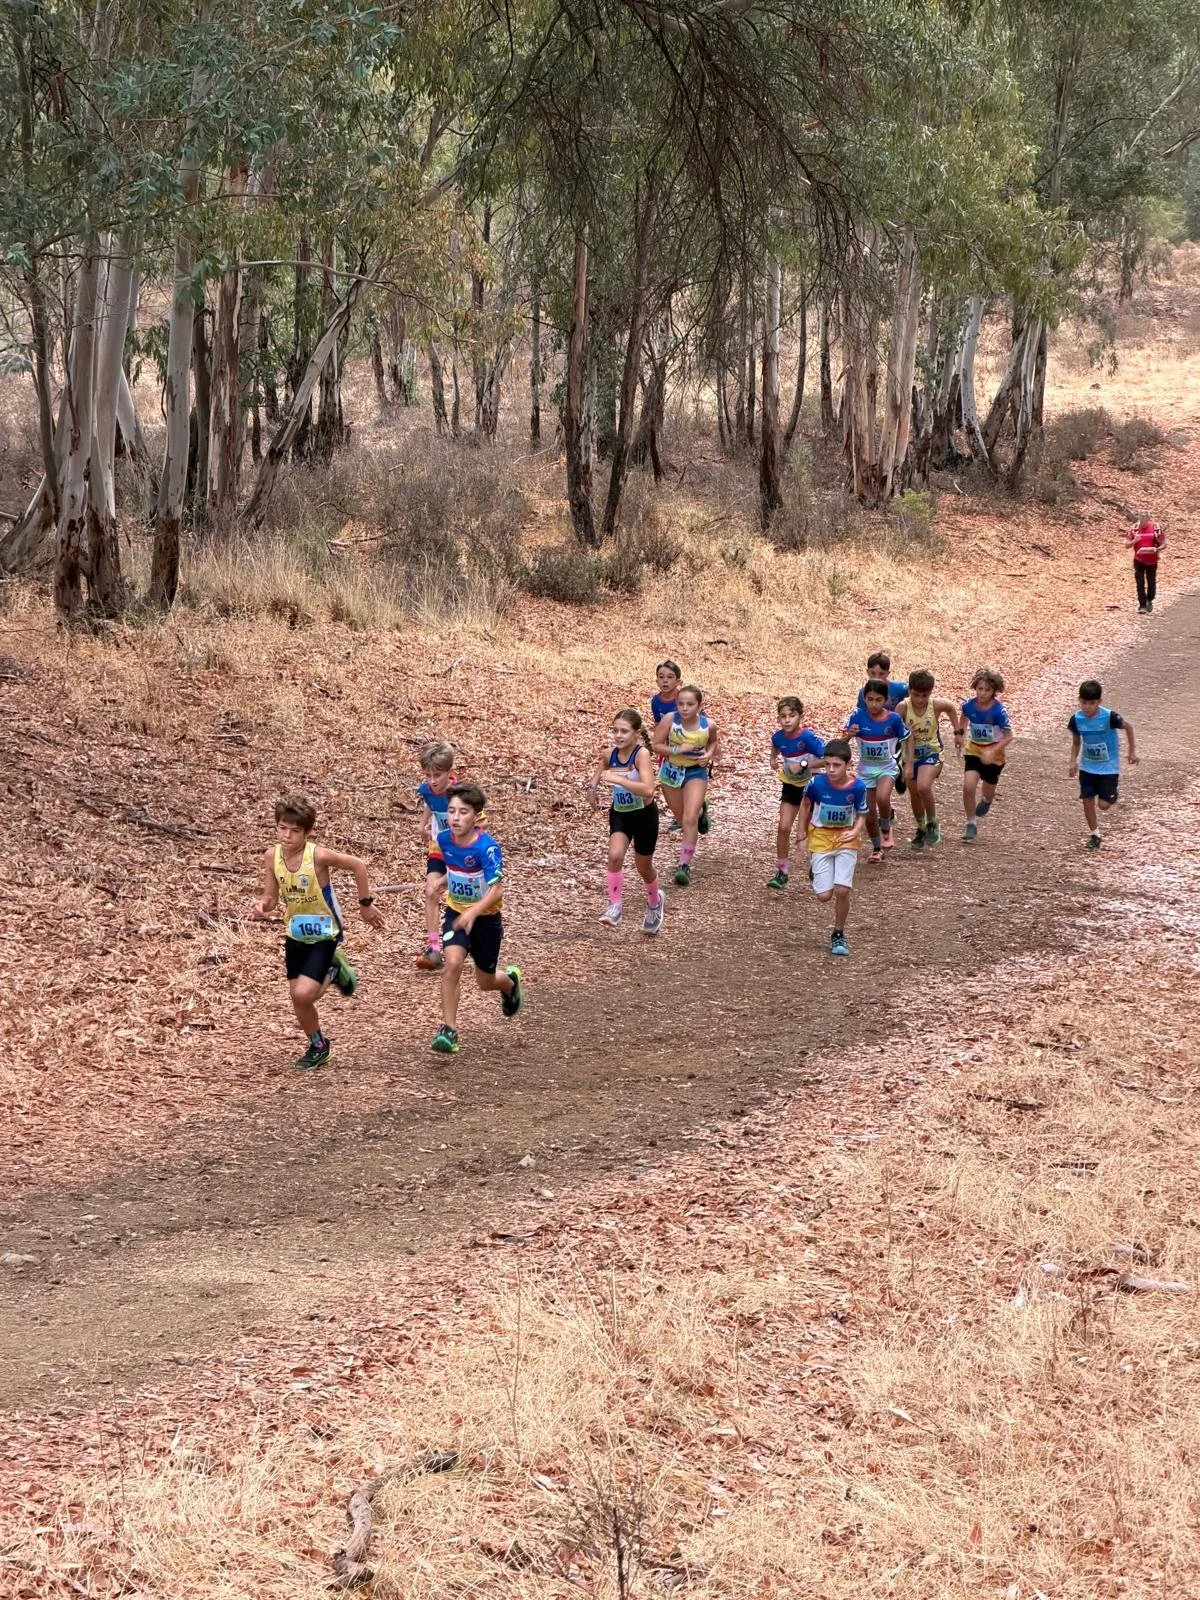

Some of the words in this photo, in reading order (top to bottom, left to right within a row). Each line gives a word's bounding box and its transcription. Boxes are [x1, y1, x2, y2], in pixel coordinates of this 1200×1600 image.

[866, 747, 883, 757] 182
[616, 792, 633, 805] 183
[826, 811, 846, 821] 185
[451, 881, 473, 896] 235
